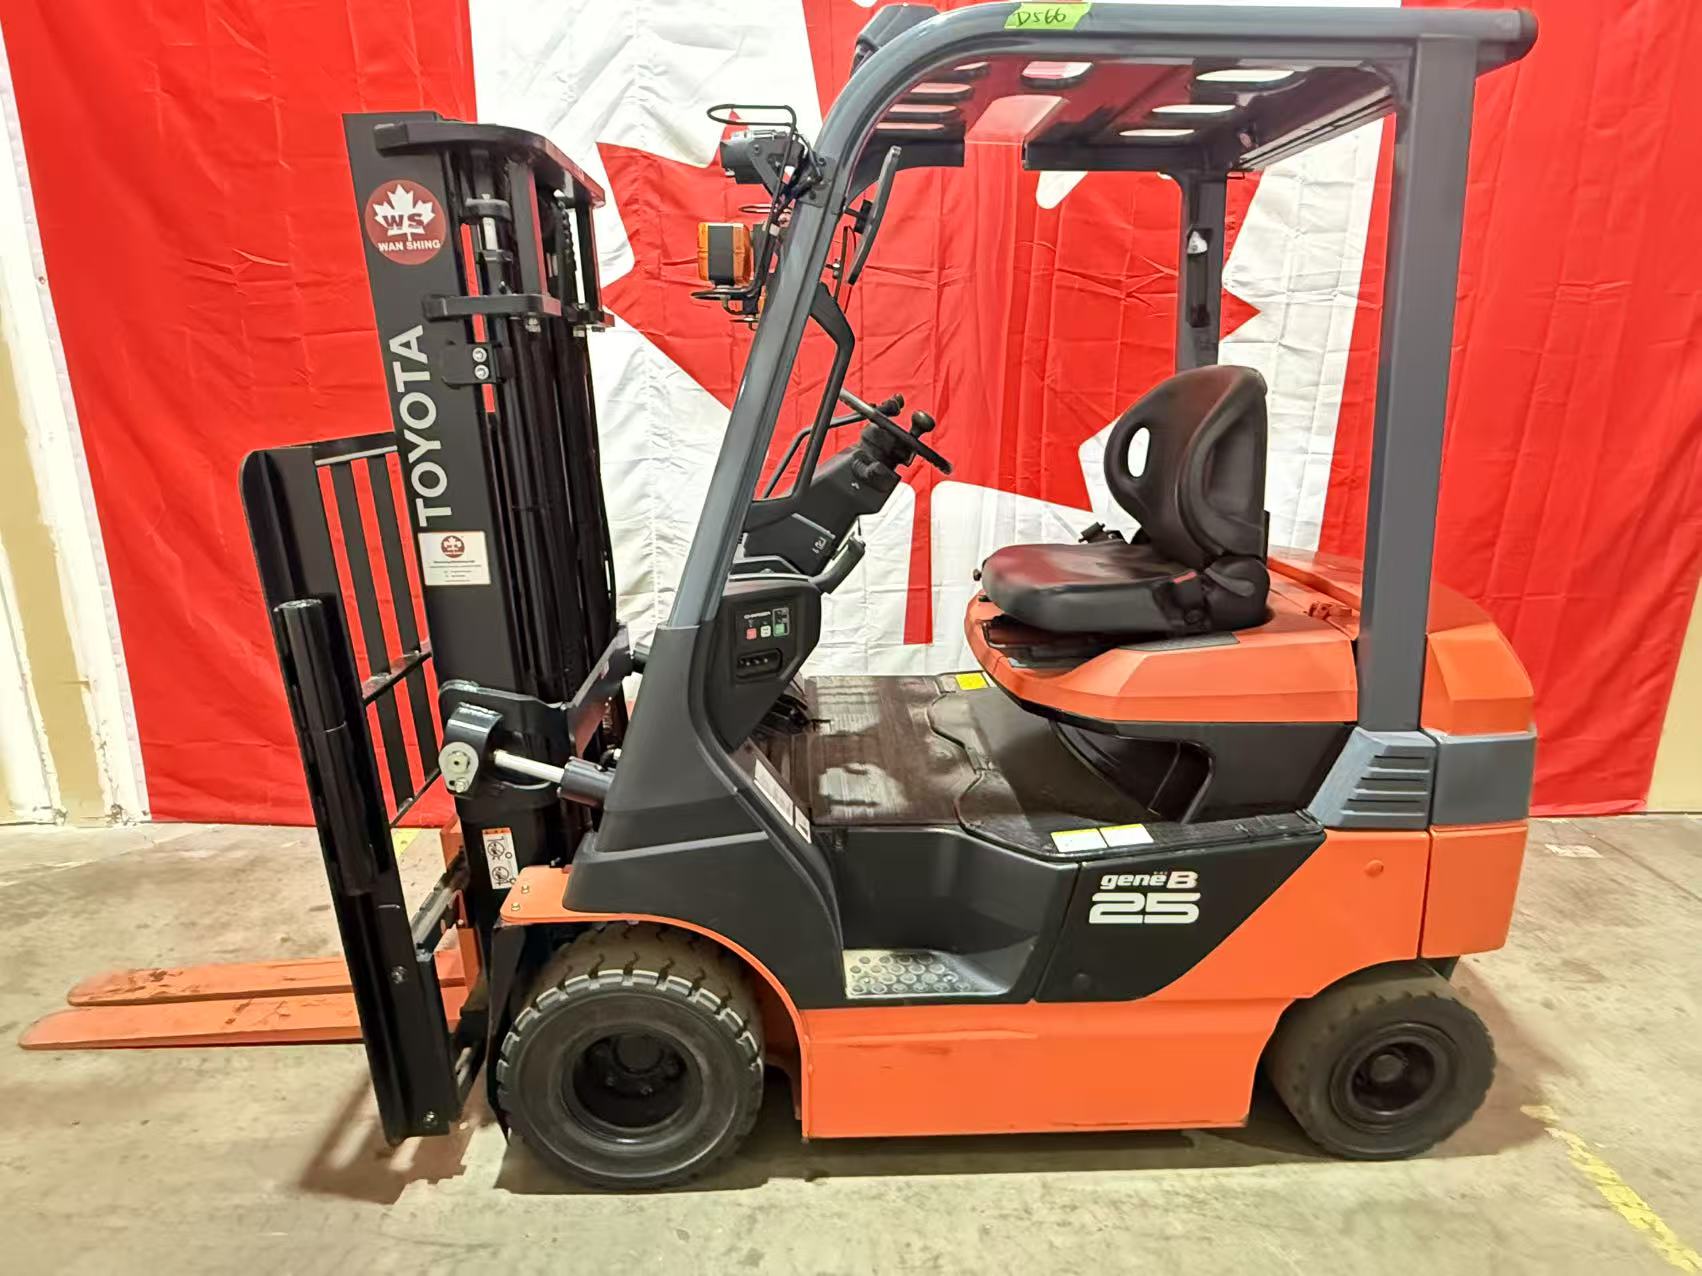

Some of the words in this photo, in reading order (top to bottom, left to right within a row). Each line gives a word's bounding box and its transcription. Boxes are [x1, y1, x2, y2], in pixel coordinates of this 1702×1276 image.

[382, 213, 425, 230] WS
[378, 241, 404, 252] WAN
[406, 239, 441, 250] SHING
[388, 324, 453, 528] TOYOTA
[1088, 892, 1201, 924] 25
